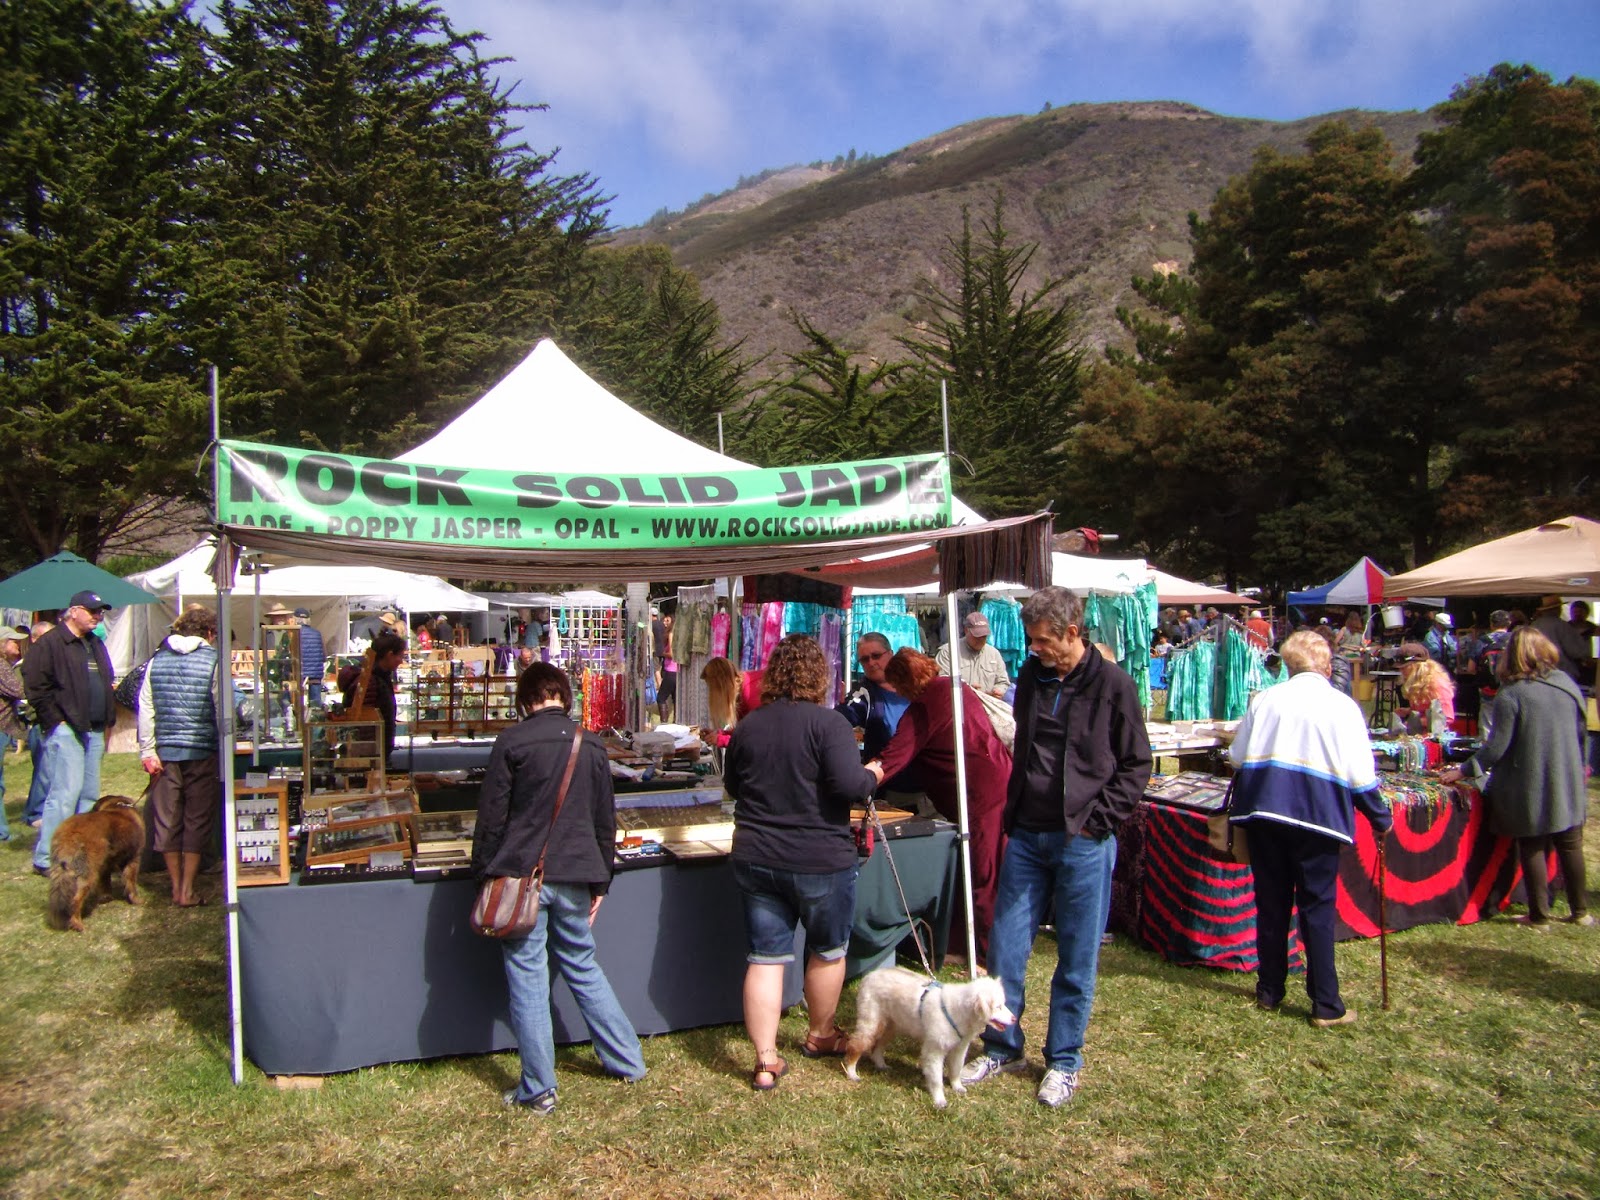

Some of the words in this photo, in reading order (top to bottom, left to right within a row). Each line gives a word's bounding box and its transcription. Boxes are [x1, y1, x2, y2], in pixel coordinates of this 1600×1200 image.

[230, 449, 473, 506] ROCK
[512, 474, 738, 509] SOLID
[775, 460, 946, 508] JADE
[327, 515, 418, 538] POPPY
[431, 517, 522, 539] JASPER
[554, 517, 620, 539] OPAL
